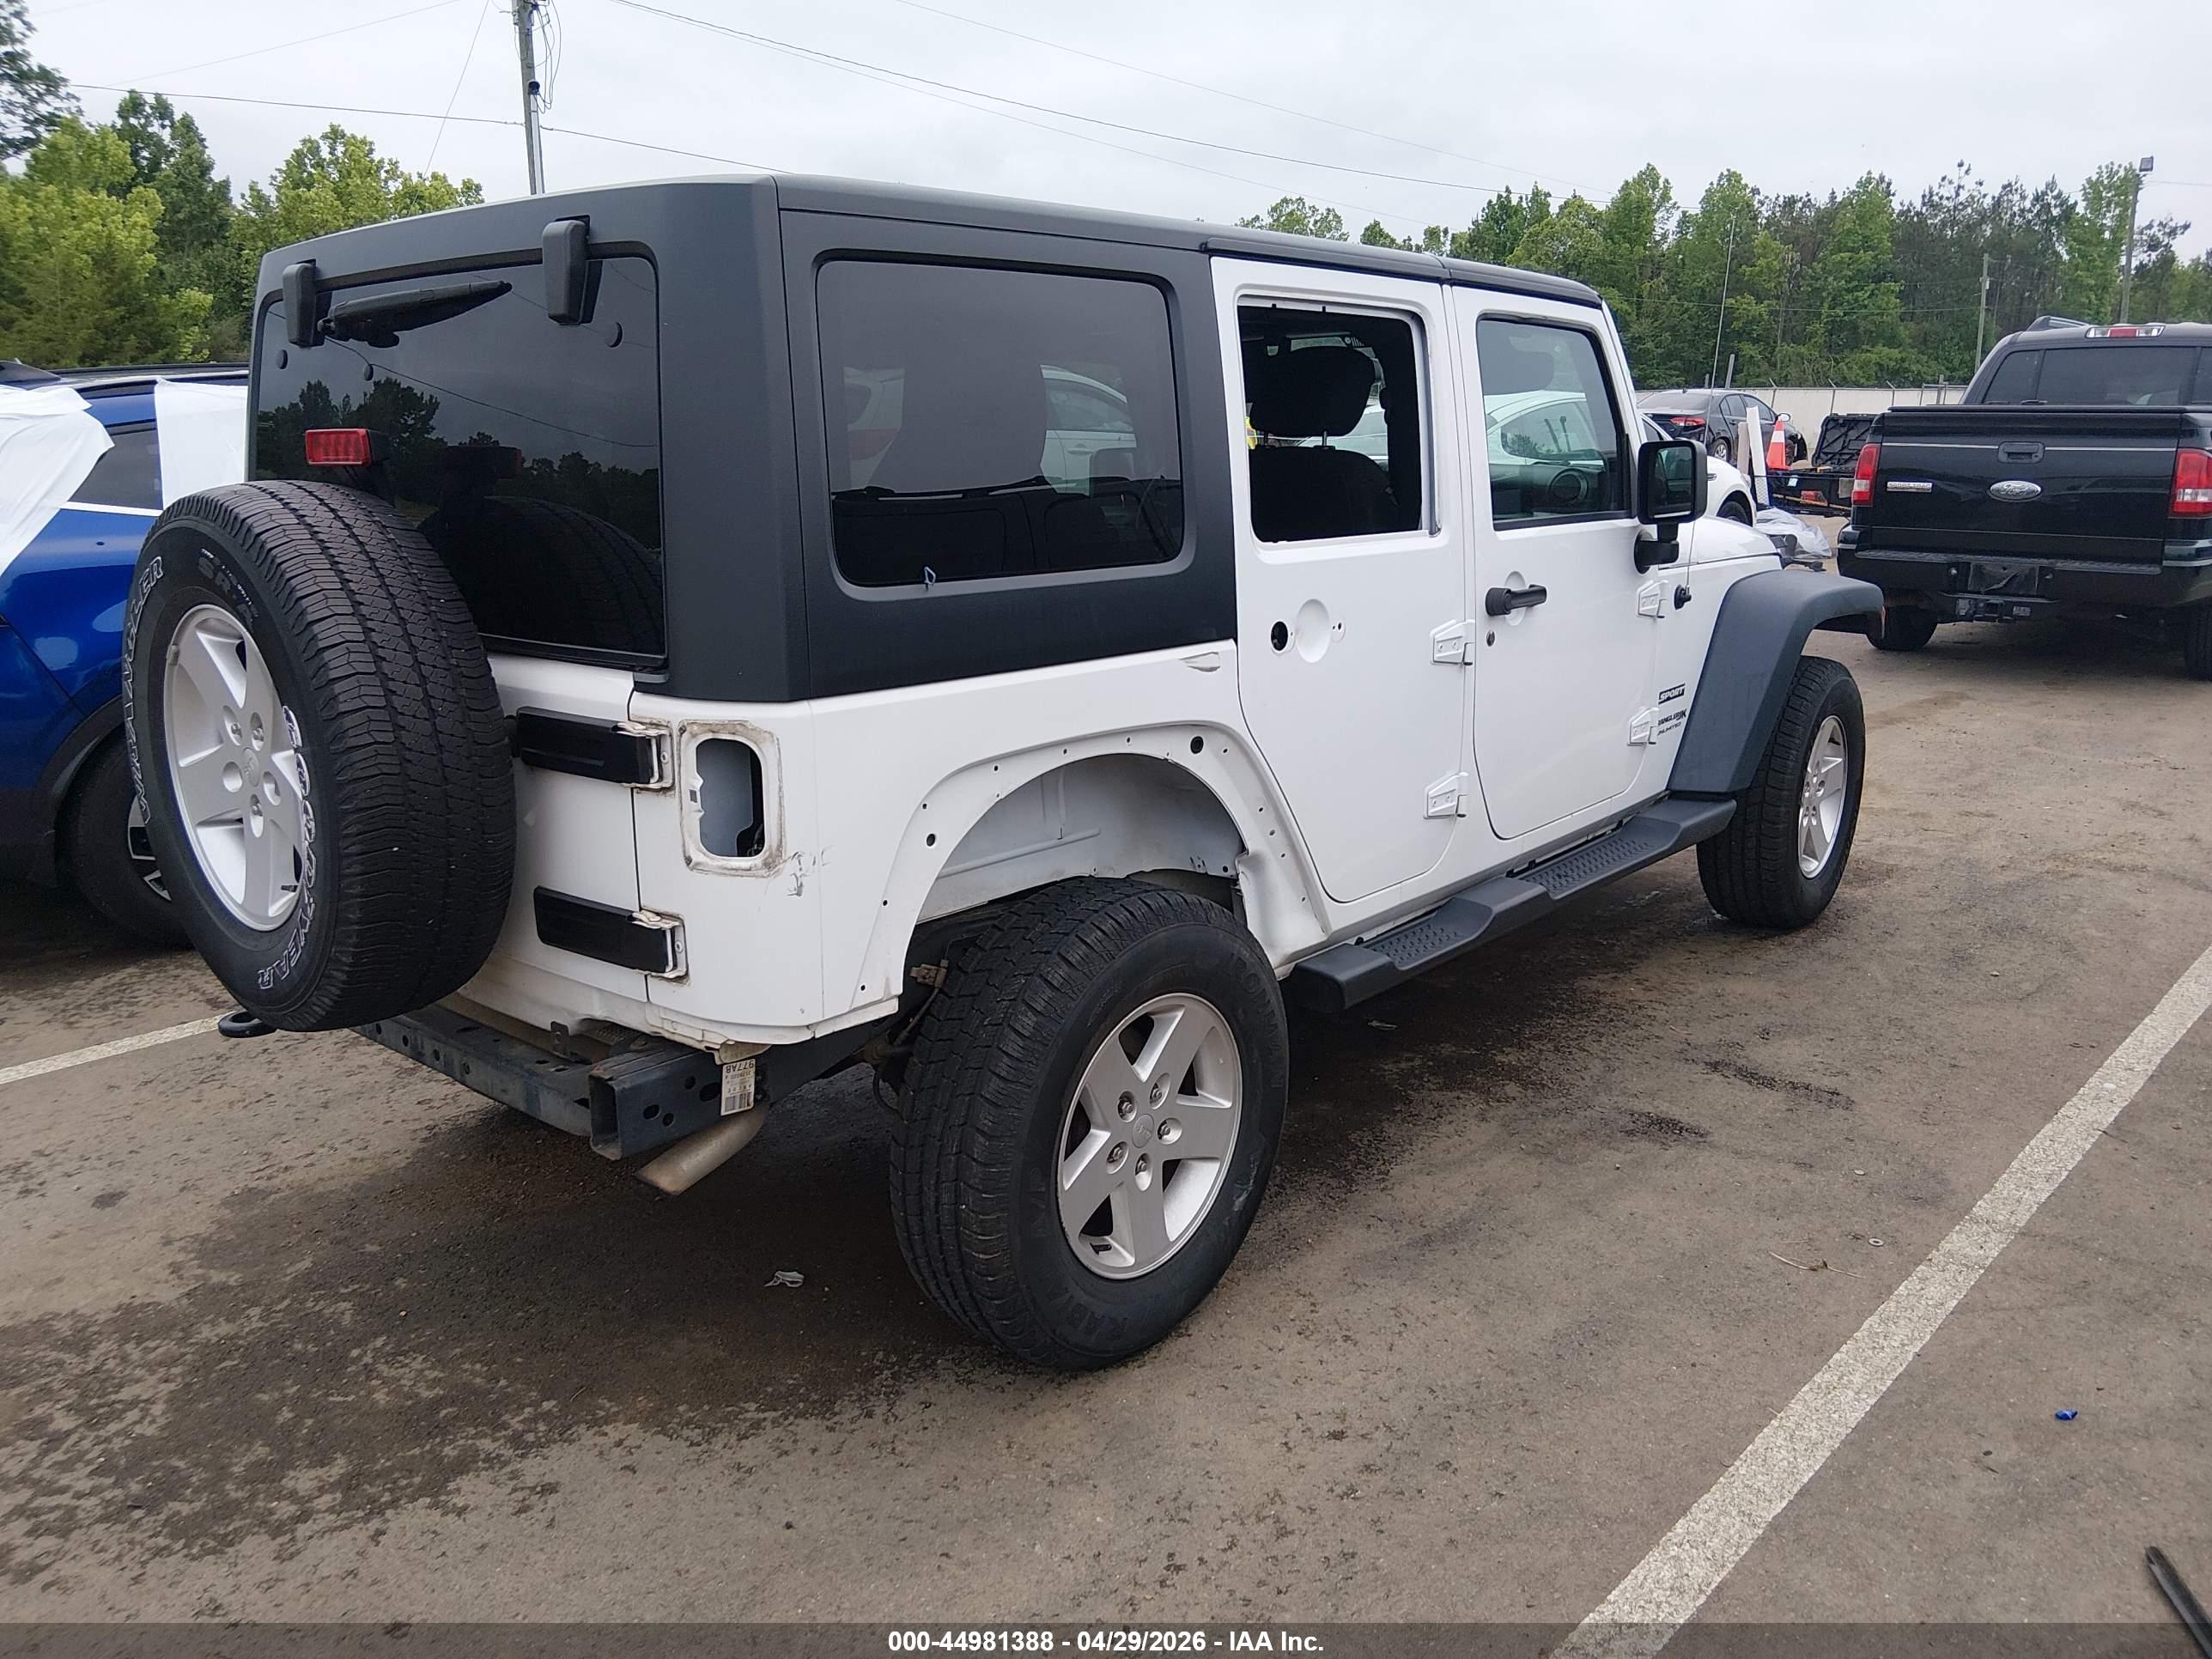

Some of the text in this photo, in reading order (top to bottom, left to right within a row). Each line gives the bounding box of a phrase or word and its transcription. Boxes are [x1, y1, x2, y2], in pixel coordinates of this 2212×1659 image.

[123, 556, 163, 824] WRANGLER
[1661, 686, 1685, 701] SPORT
[257, 705, 318, 990] GOODYEAR
[726, 1060, 754, 1073] 977AB
